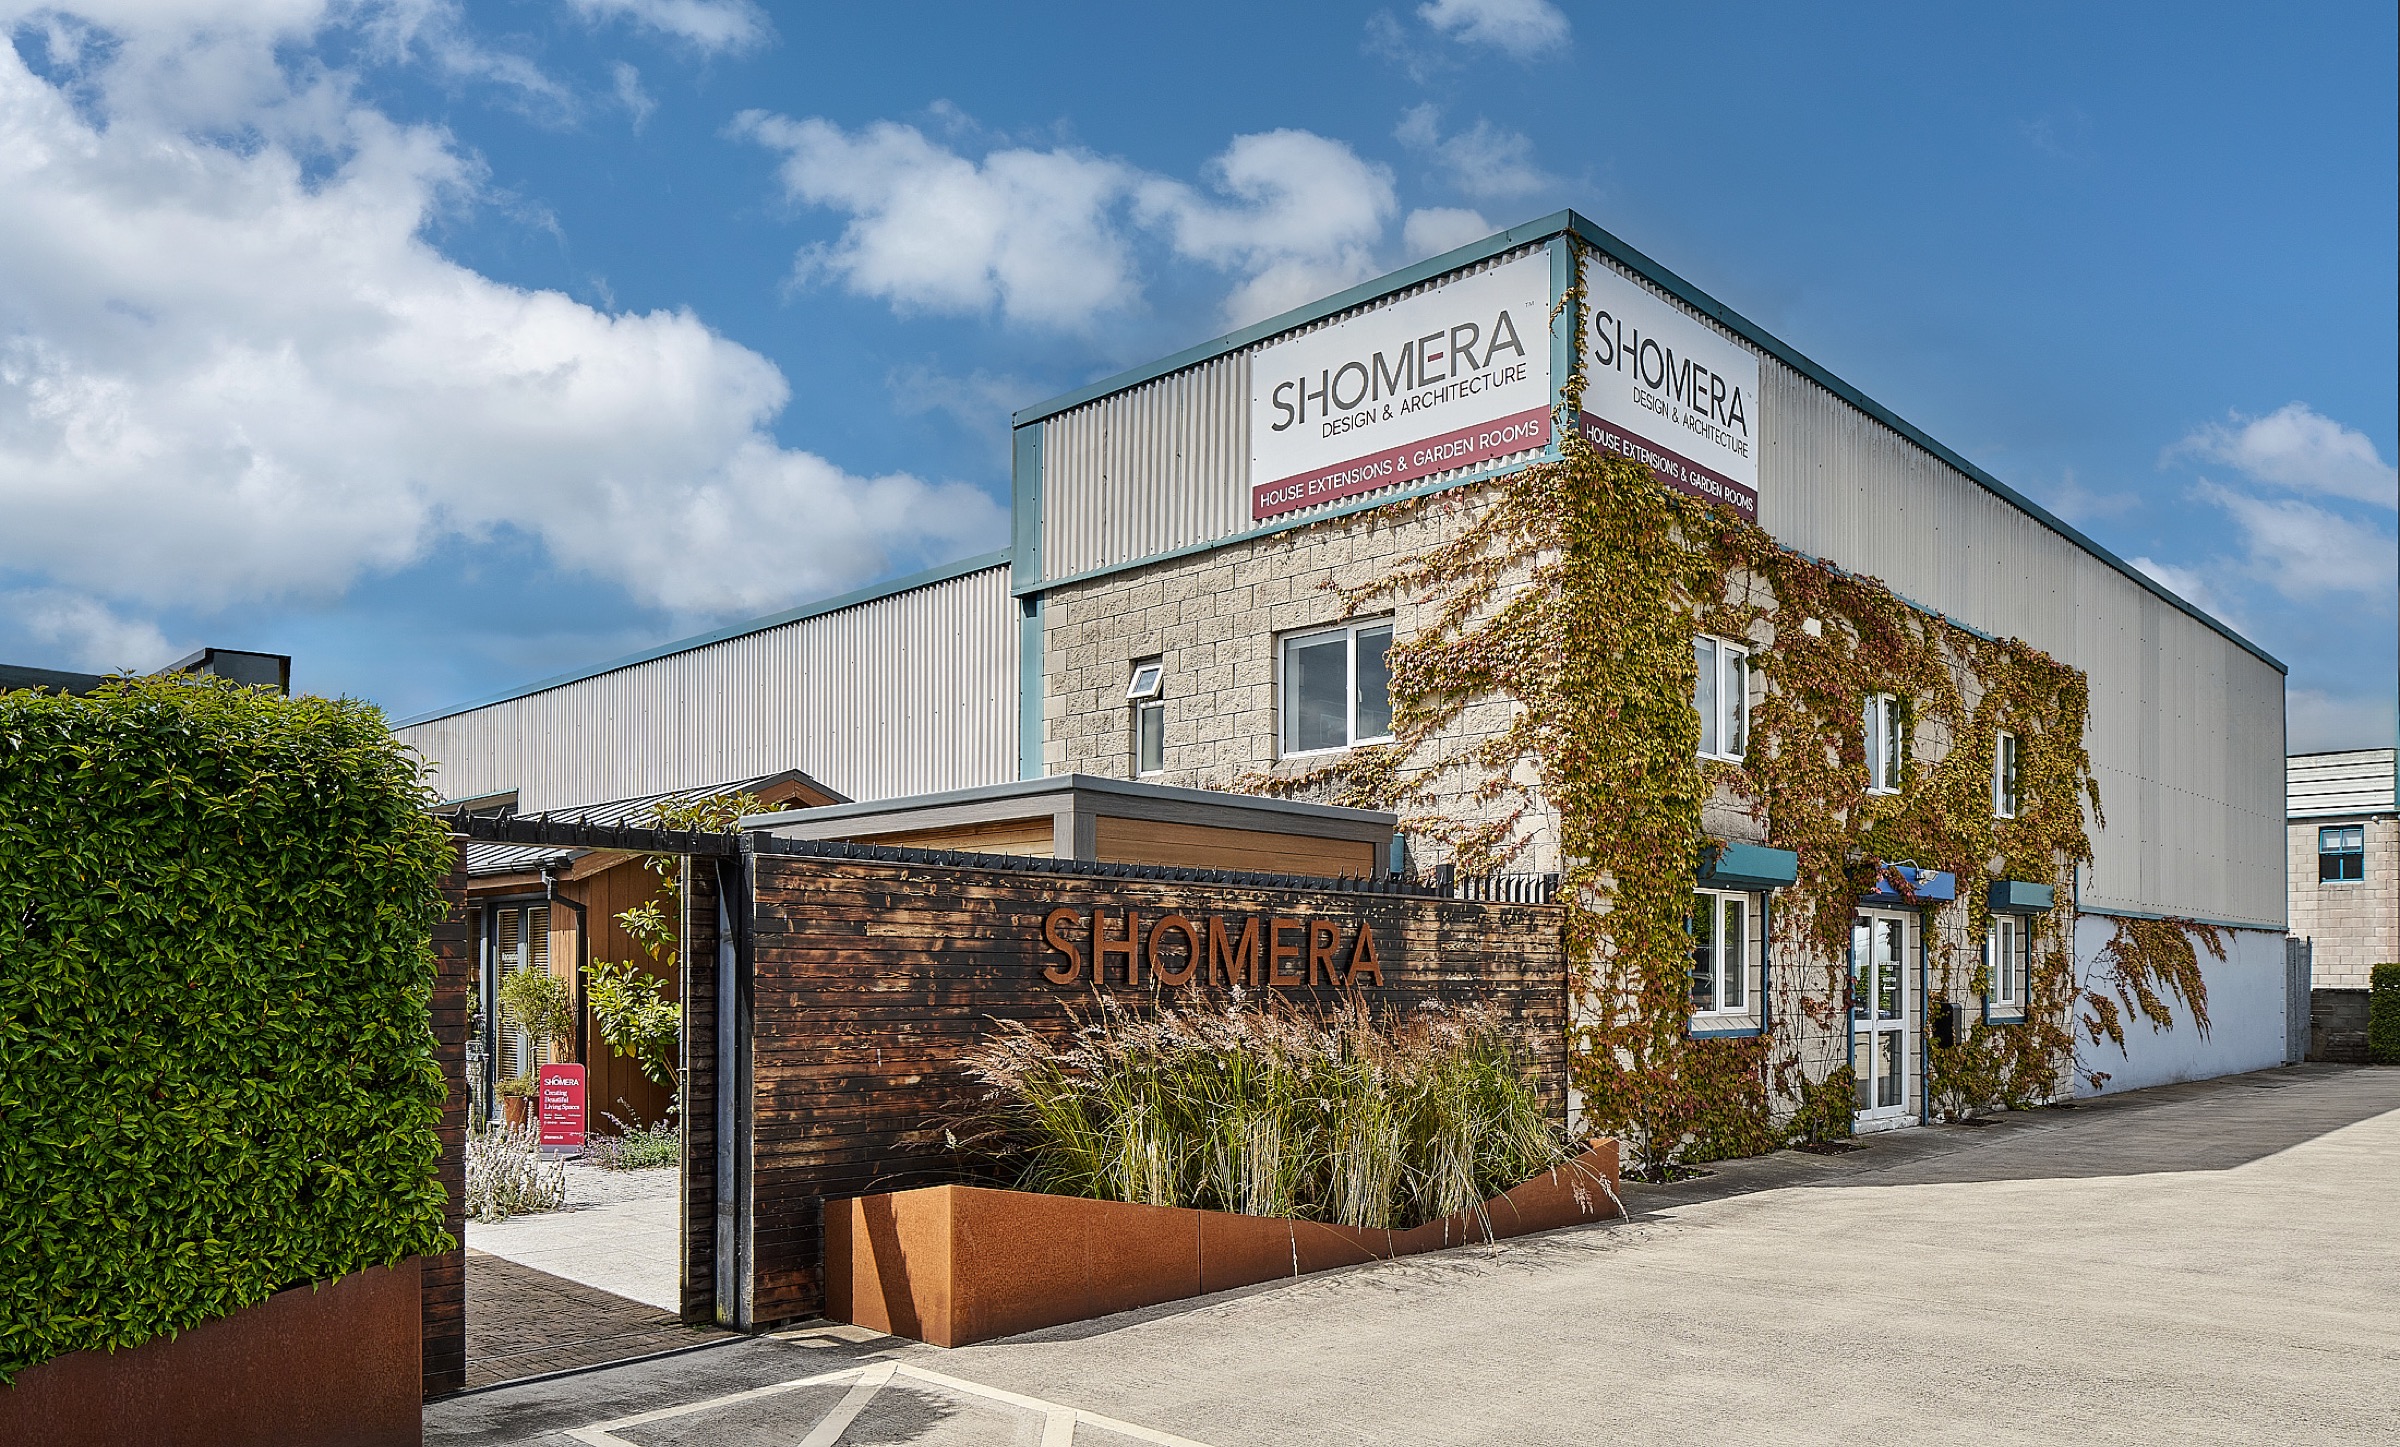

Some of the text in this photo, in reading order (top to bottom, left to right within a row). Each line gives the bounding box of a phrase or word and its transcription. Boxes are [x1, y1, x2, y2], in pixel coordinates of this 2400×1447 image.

[1271, 310, 1526, 432] SHOMERA
[1322, 362, 1527, 438] DESIGN & ARCHITECTURE
[1594, 310, 1748, 437] SHOMERA
[1633, 386, 1749, 458] DESIGN & ARCHITECTURE
[1260, 419, 1540, 508] HOUSE EXTENSIONS & GARDEN ROOMS
[1586, 423, 1754, 512] HOUSE EXTENSIONS & GARDEN ROOMS
[1042, 907, 1384, 987] SHOMERA
[544, 1077, 580, 1086] SHOMERA
[544, 1089, 568, 1097] Creating
